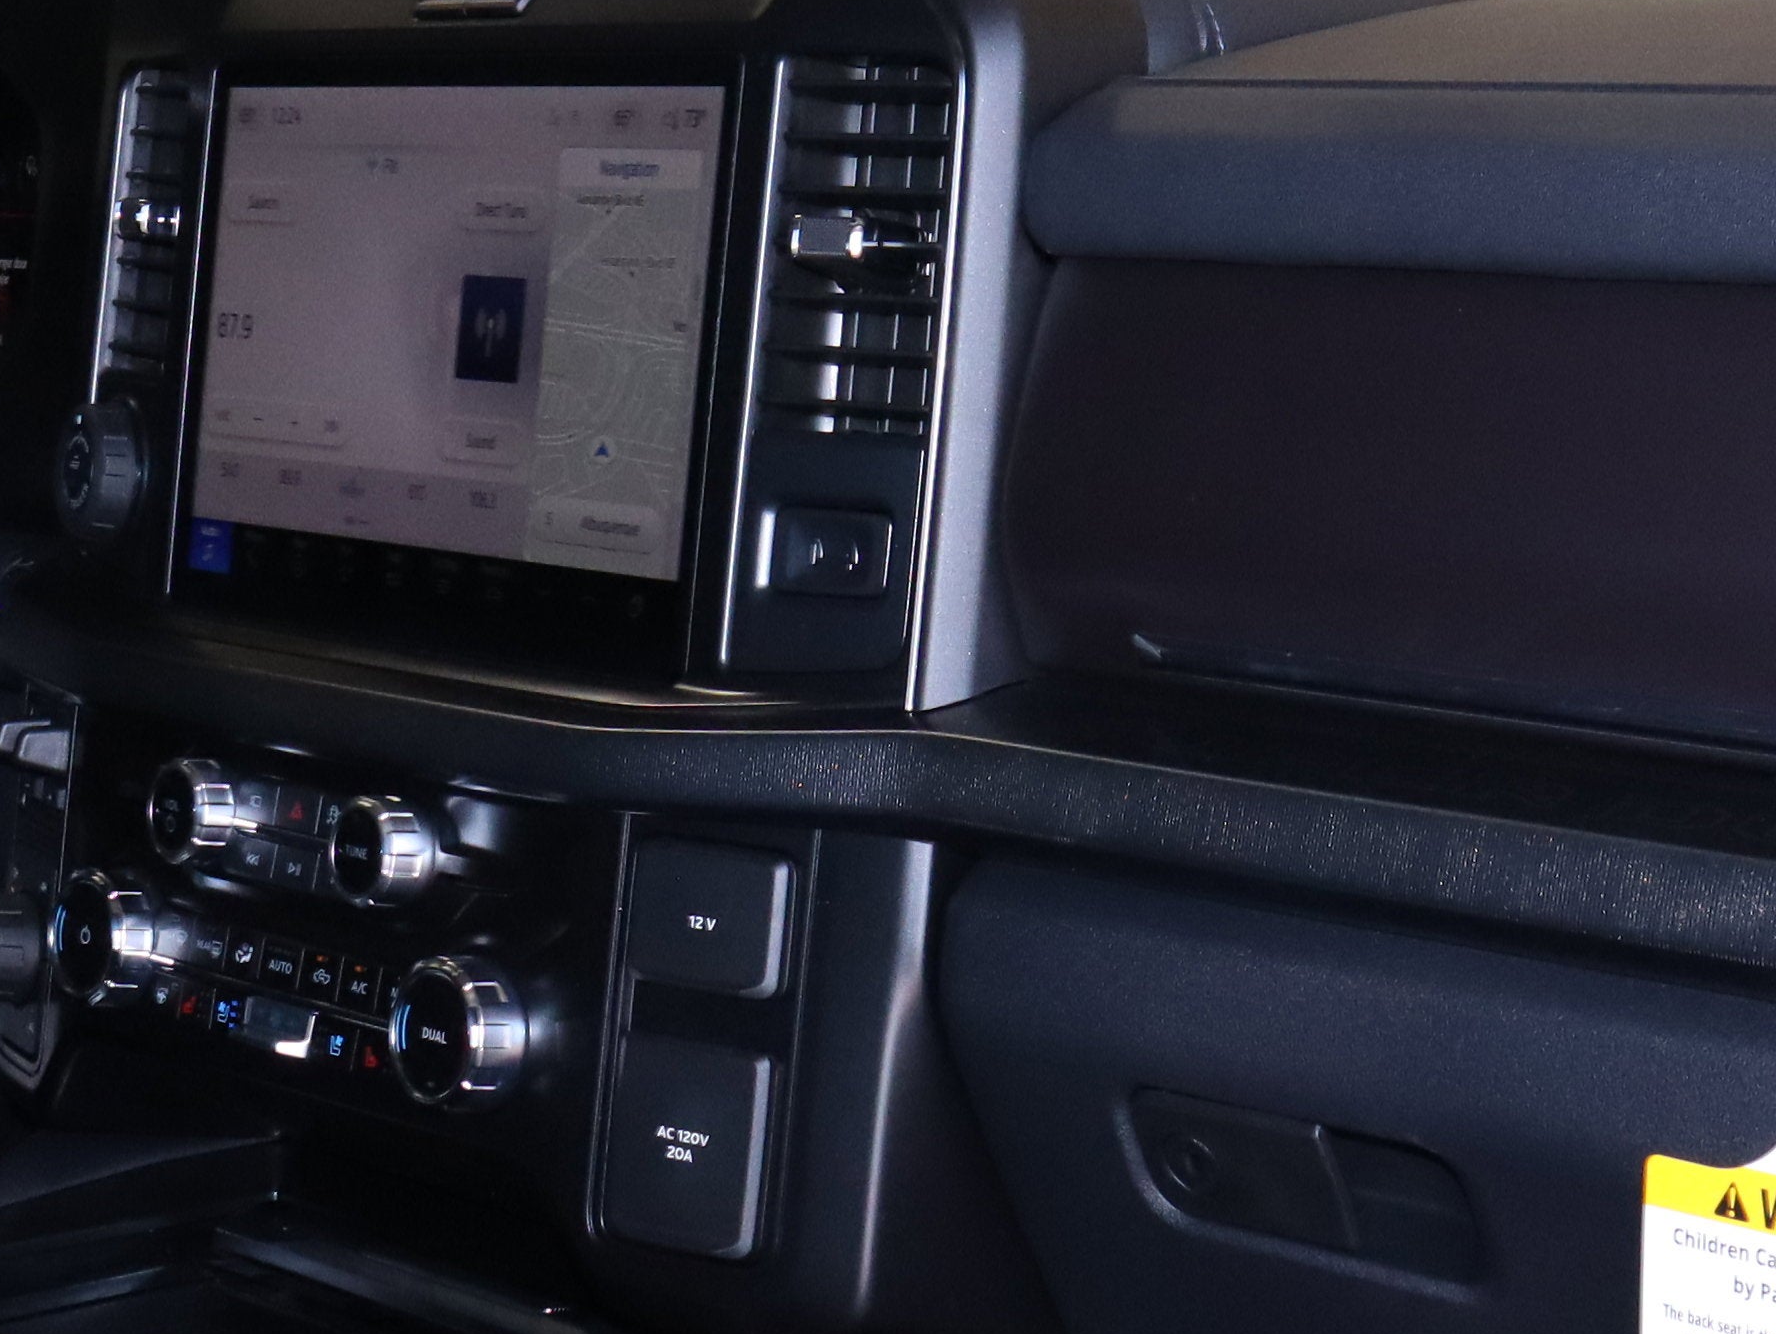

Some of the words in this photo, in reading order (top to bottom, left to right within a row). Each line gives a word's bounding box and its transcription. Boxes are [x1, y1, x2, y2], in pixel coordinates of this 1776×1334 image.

[345, 845, 369, 861] TUNE
[268, 959, 294, 976] AUTO
[350, 980, 369, 996] A/C
[421, 1026, 448, 1046] DUAL
[656, 1125, 675, 1141] AC
[677, 1129, 710, 1148] 120V
[666, 1145, 693, 1163] 20A
[1674, 1228, 1750, 1263] Children
[1734, 1275, 1754, 1301] by
[1663, 1302, 1684, 1322] The
[1687, 1310, 1714, 1330] back
